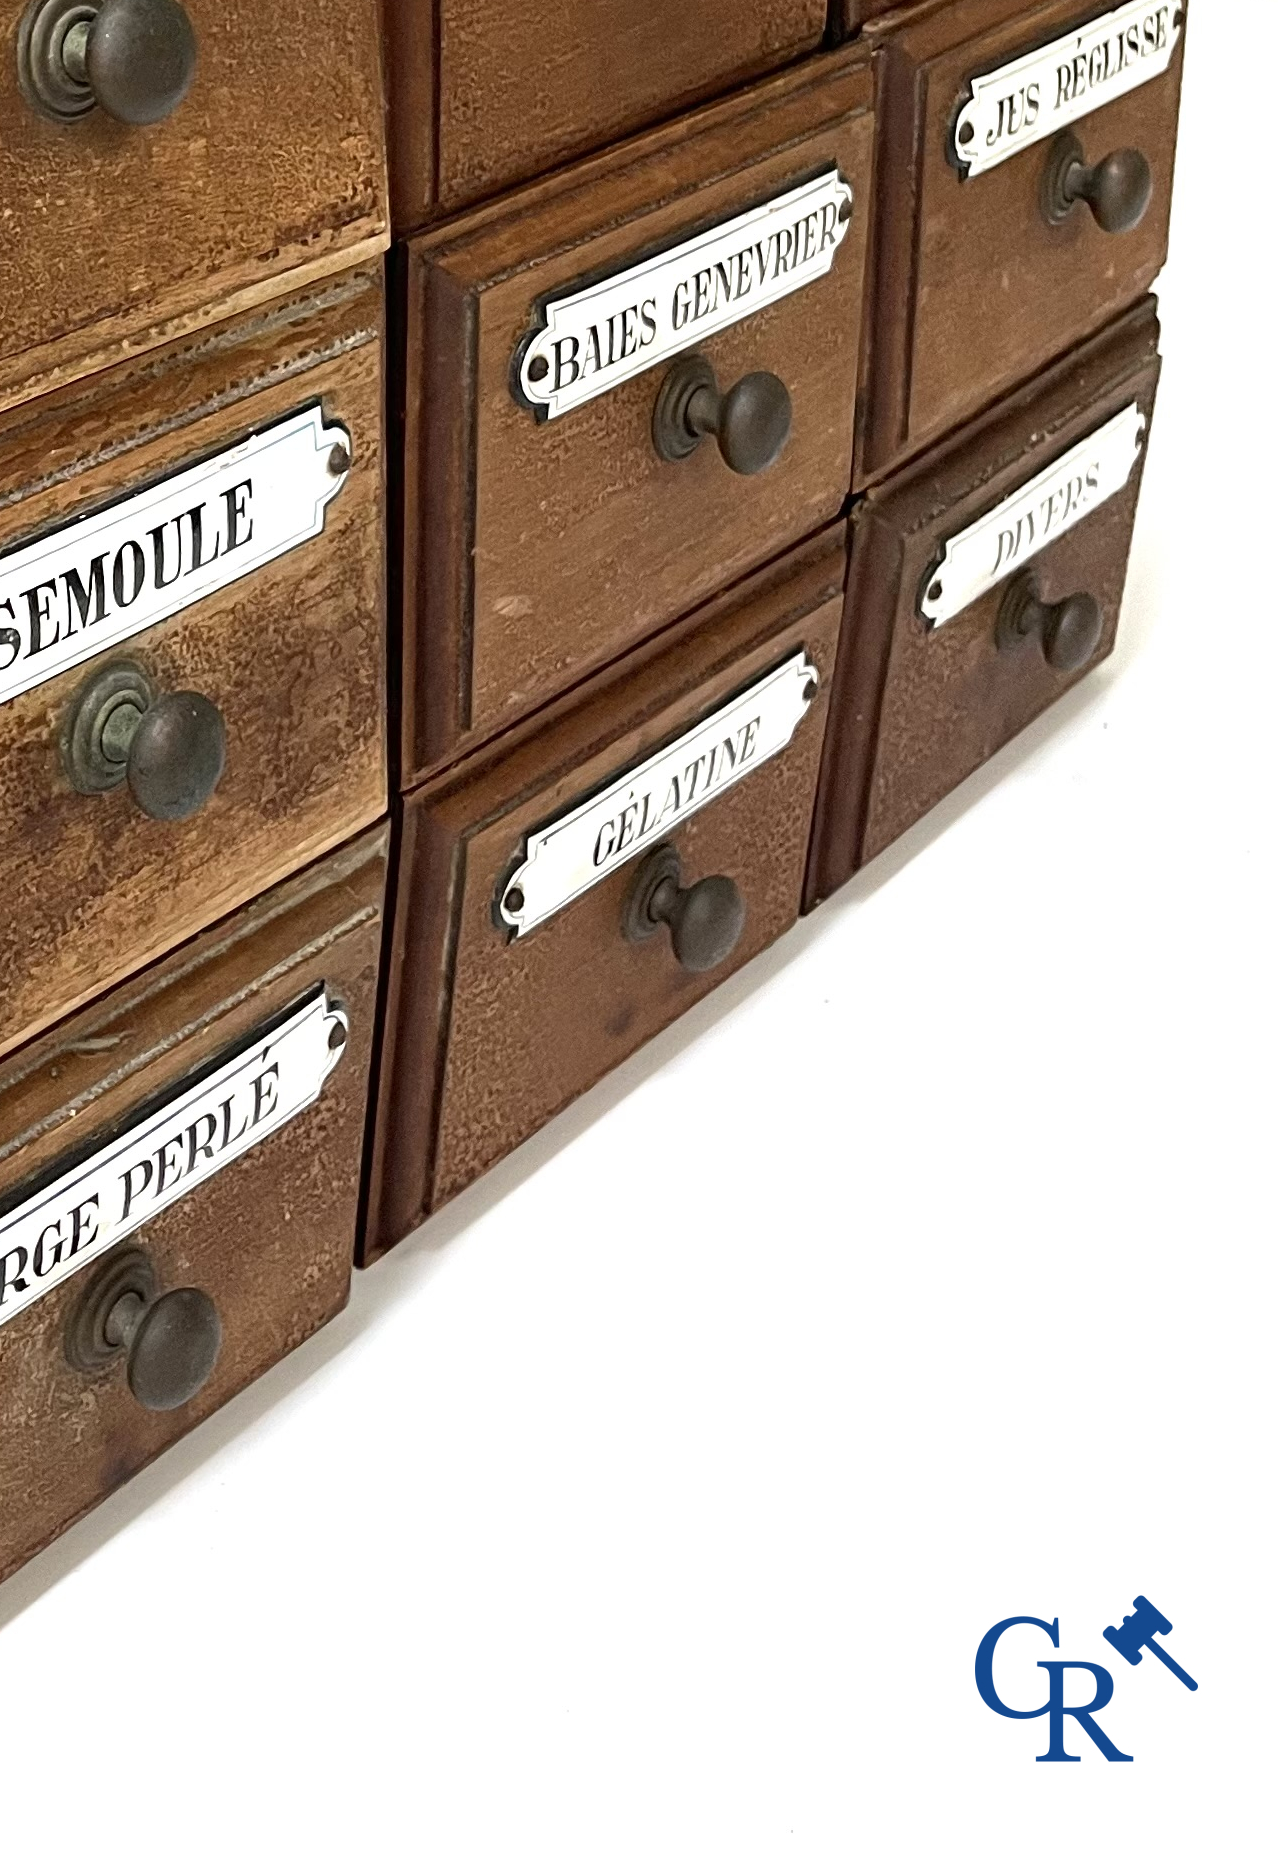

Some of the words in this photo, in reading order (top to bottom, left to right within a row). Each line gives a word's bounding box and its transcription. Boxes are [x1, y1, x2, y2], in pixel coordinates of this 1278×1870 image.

[986, 83, 1040, 146] JUS
[1053, 6, 1168, 110] RÉGLISSE
[549, 296, 657, 393] BAIES
[672, 201, 837, 331] GENEVRIER
[991, 462, 1100, 576] DIVERS
[593, 715, 760, 866] GÉLATINE
[114, 1045, 279, 1228] PERLÉ
